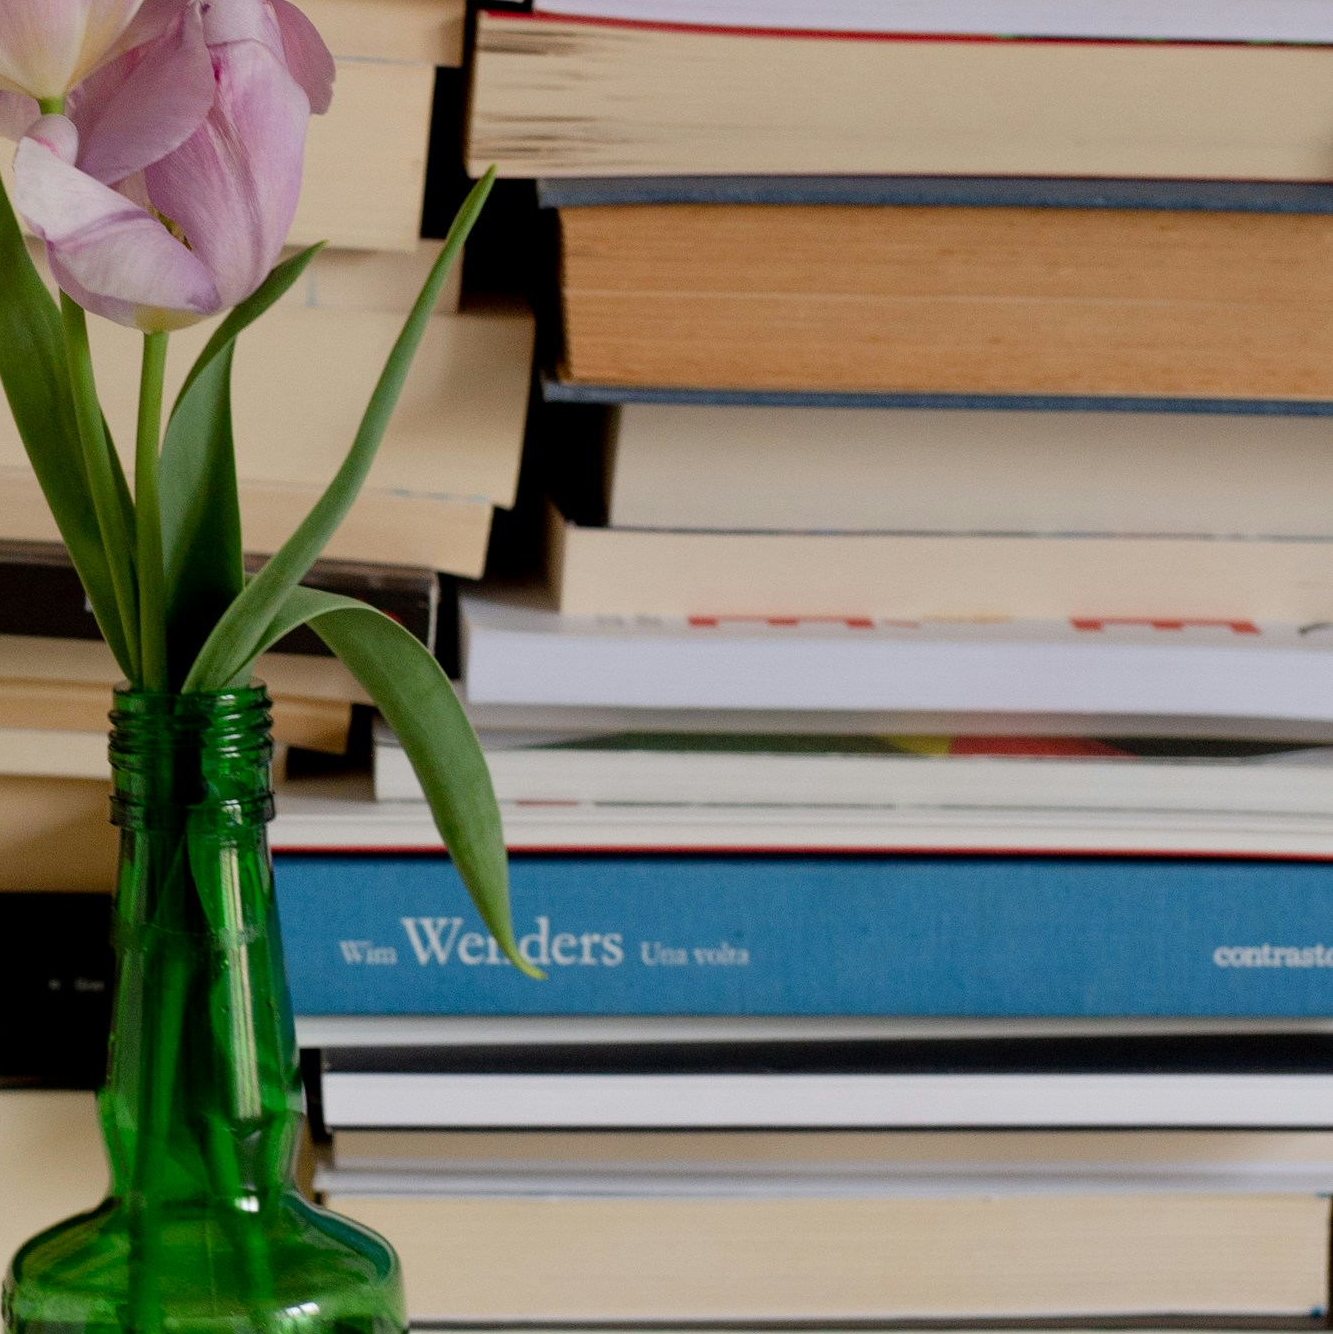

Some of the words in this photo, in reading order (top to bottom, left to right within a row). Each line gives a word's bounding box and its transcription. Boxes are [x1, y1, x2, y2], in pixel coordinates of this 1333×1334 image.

[338, 938, 399, 967] Wim
[639, 940, 690, 968] Una
[692, 942, 751, 969] volta
